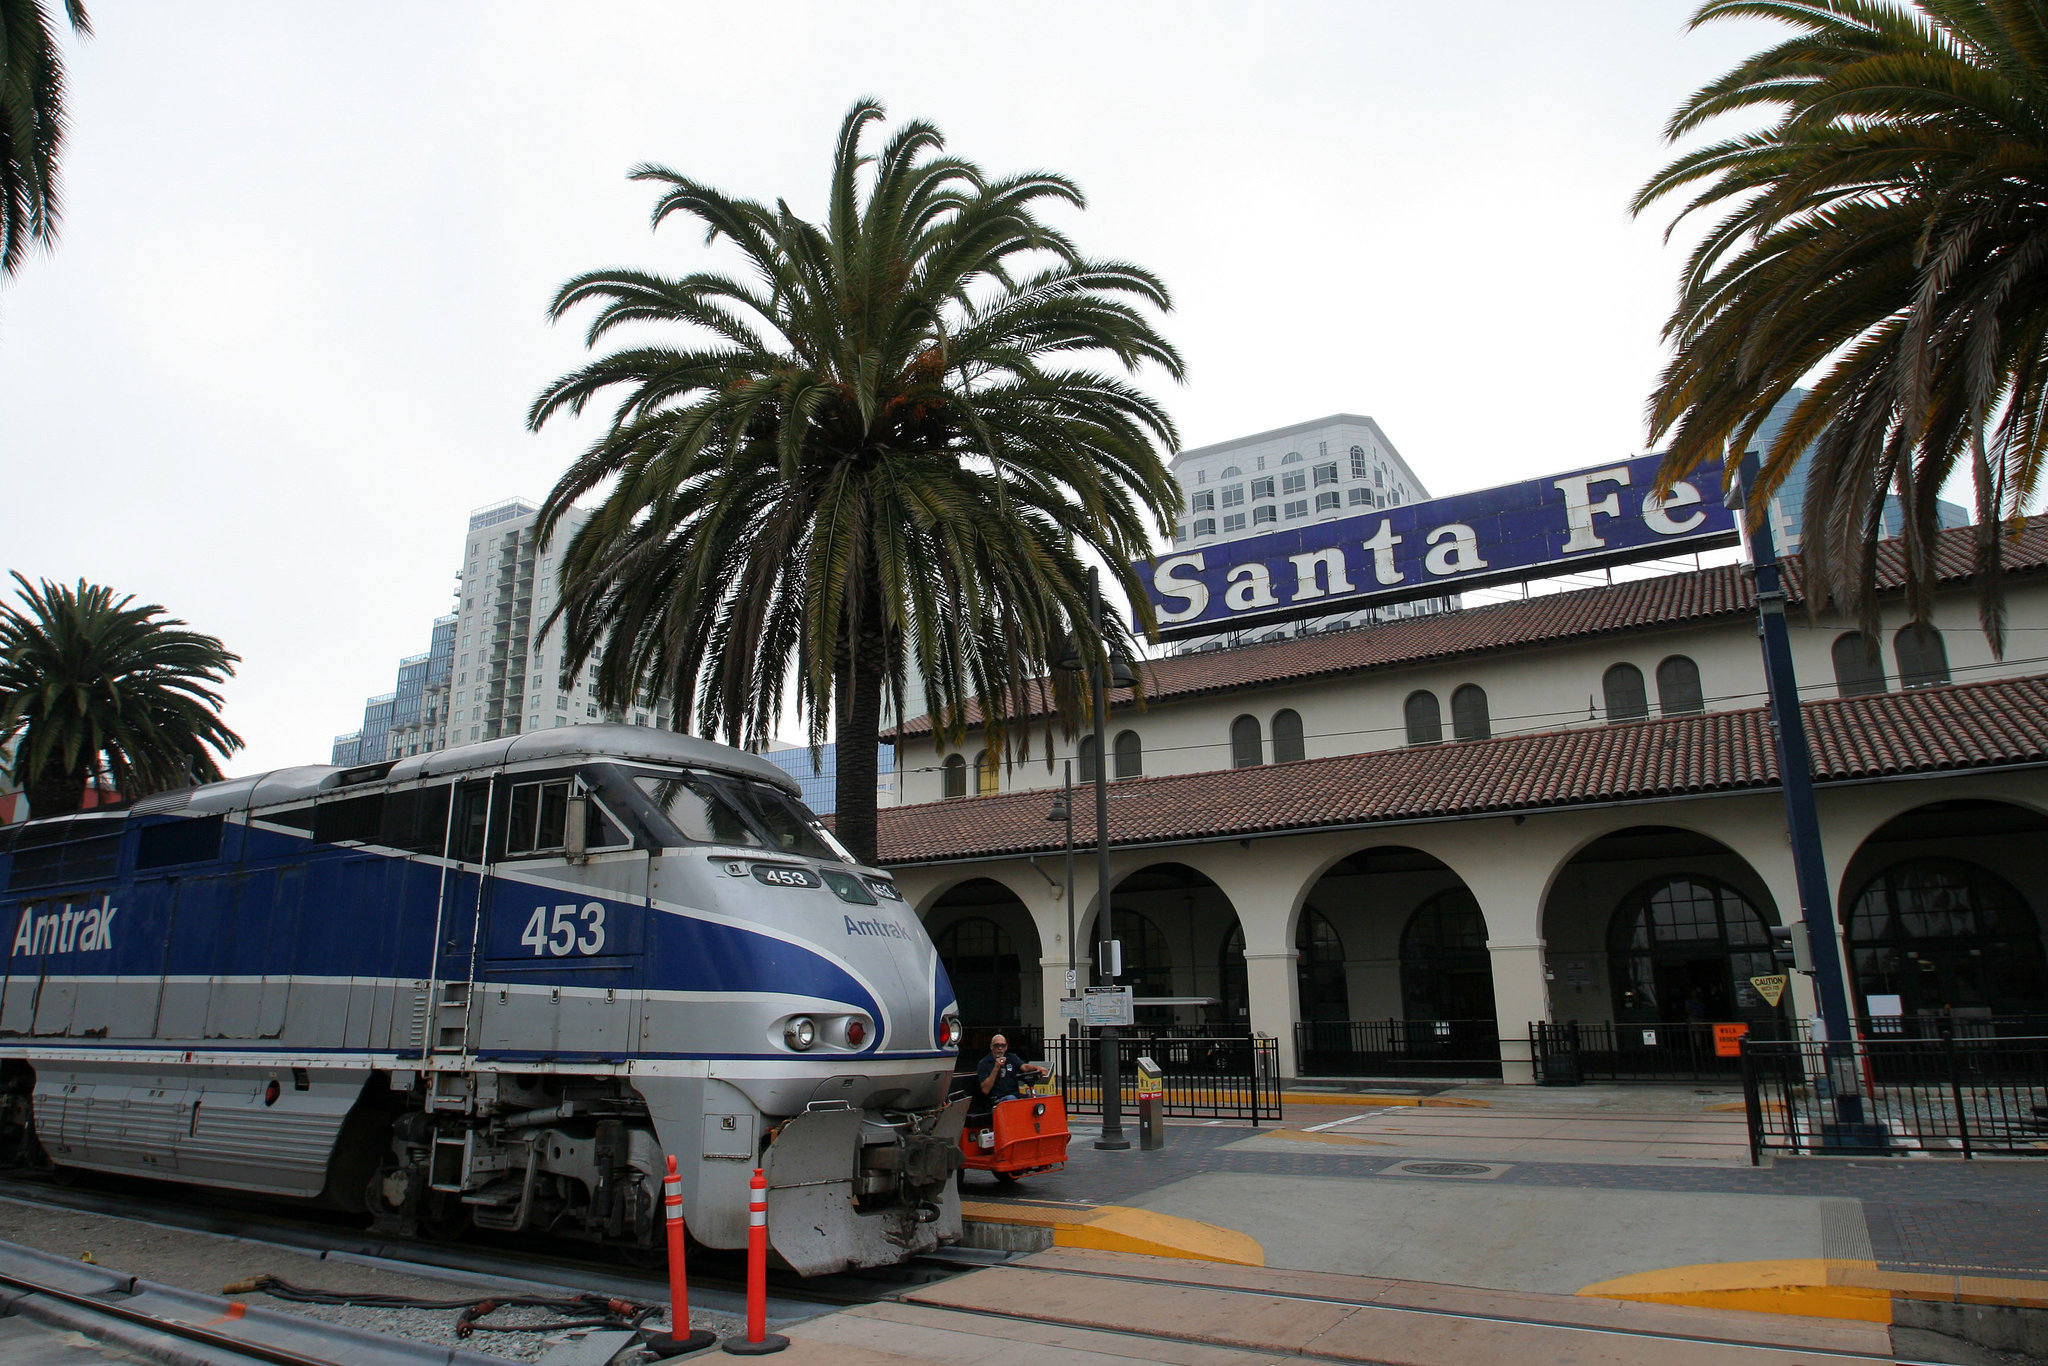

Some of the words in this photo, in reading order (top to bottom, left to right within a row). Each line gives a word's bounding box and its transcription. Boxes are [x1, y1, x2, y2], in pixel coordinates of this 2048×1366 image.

[1153, 517, 1489, 626] Santa
[1553, 466, 1707, 554] Fe
[766, 870, 808, 886] 453
[11, 895, 118, 957] Amtrak
[521, 901, 606, 956] 453
[844, 914, 912, 941] Amtrak
[1754, 977, 1783, 986] CAUTION
